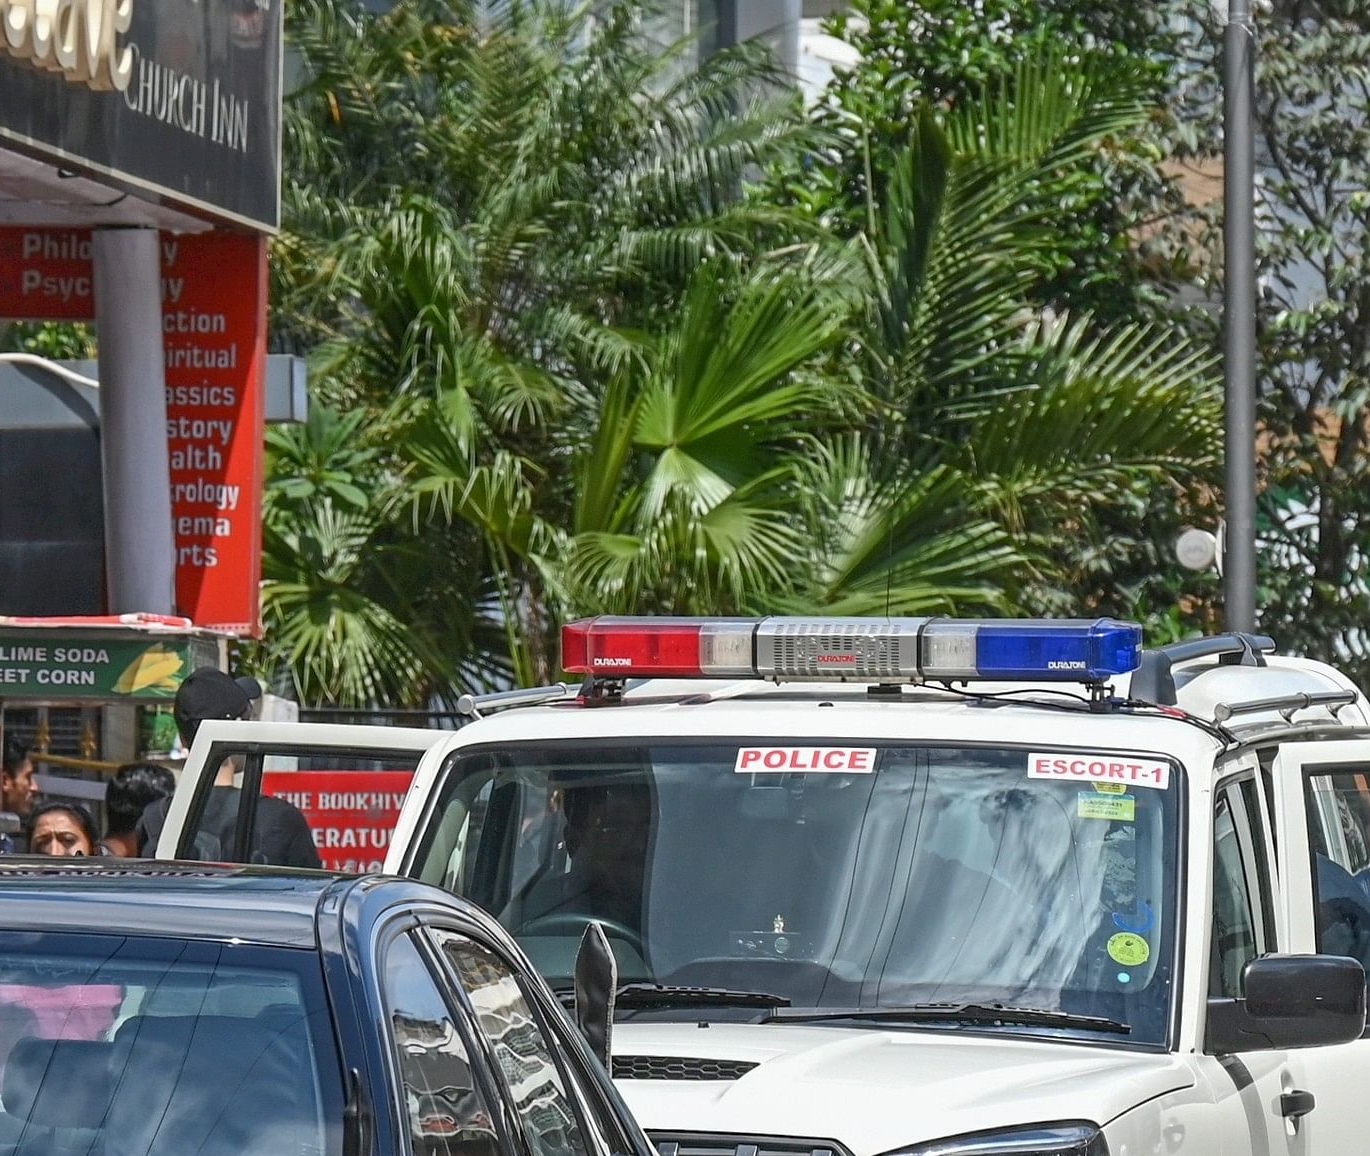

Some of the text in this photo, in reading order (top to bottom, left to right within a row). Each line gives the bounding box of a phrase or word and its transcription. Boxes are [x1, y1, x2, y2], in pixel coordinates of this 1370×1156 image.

[124, 42, 206, 137] CHURCH
[211, 77, 249, 153] INN
[54, 647, 110, 664] SODA
[36, 669, 95, 685] CORN
[740, 750, 870, 769] POLICE
[1035, 759, 1163, 783] ESCORT-1
